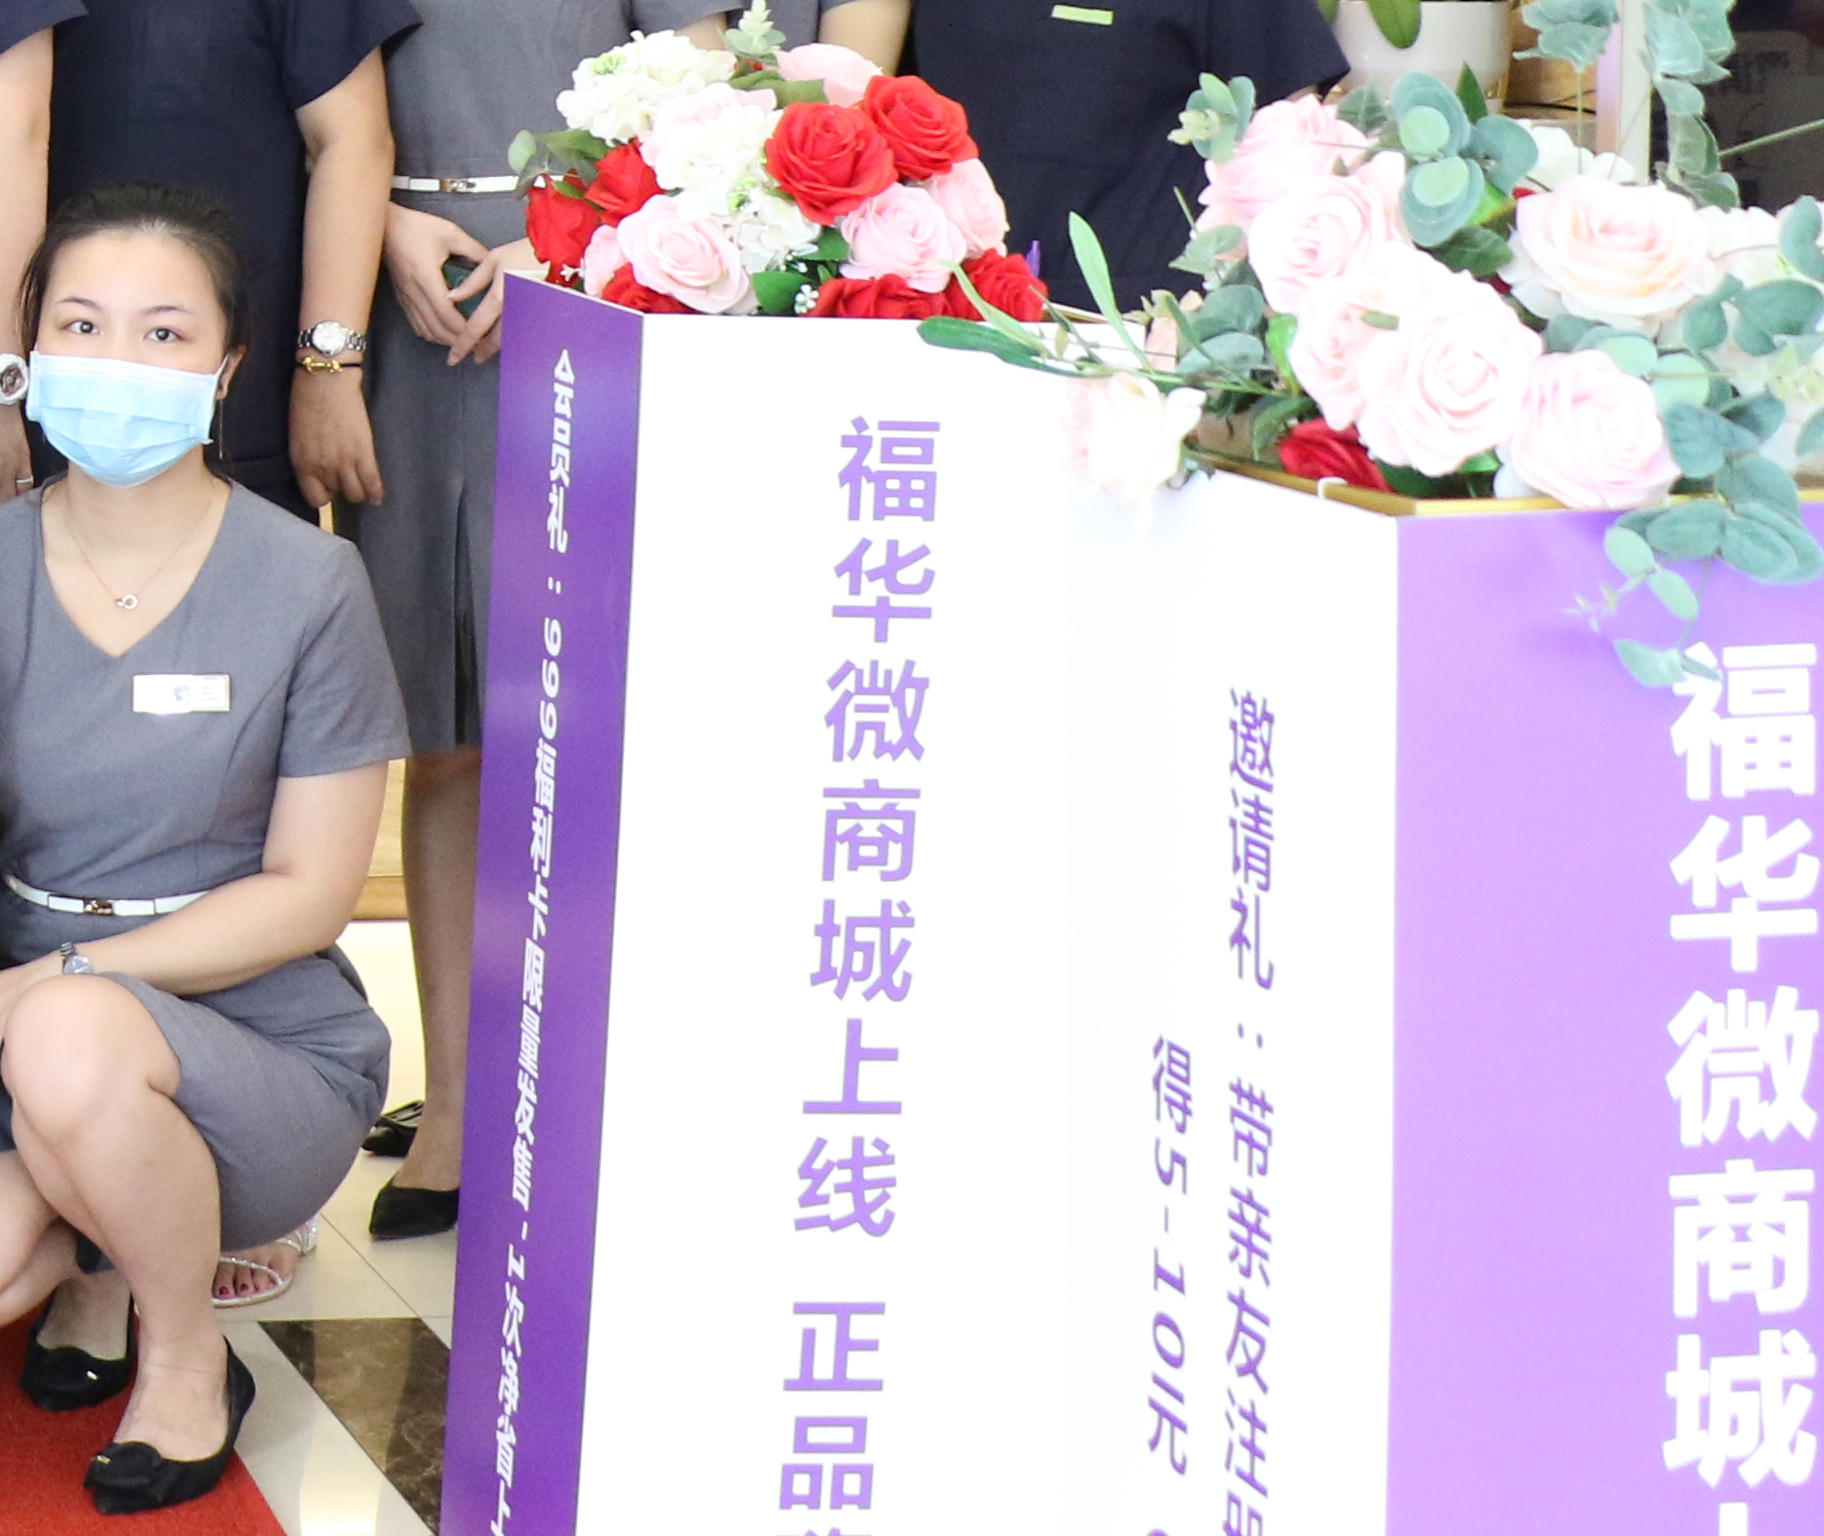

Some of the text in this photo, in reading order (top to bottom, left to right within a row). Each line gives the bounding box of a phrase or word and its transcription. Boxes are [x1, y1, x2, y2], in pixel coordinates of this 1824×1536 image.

[776, 416, 940, 1536] 福华微商城上线 正品
